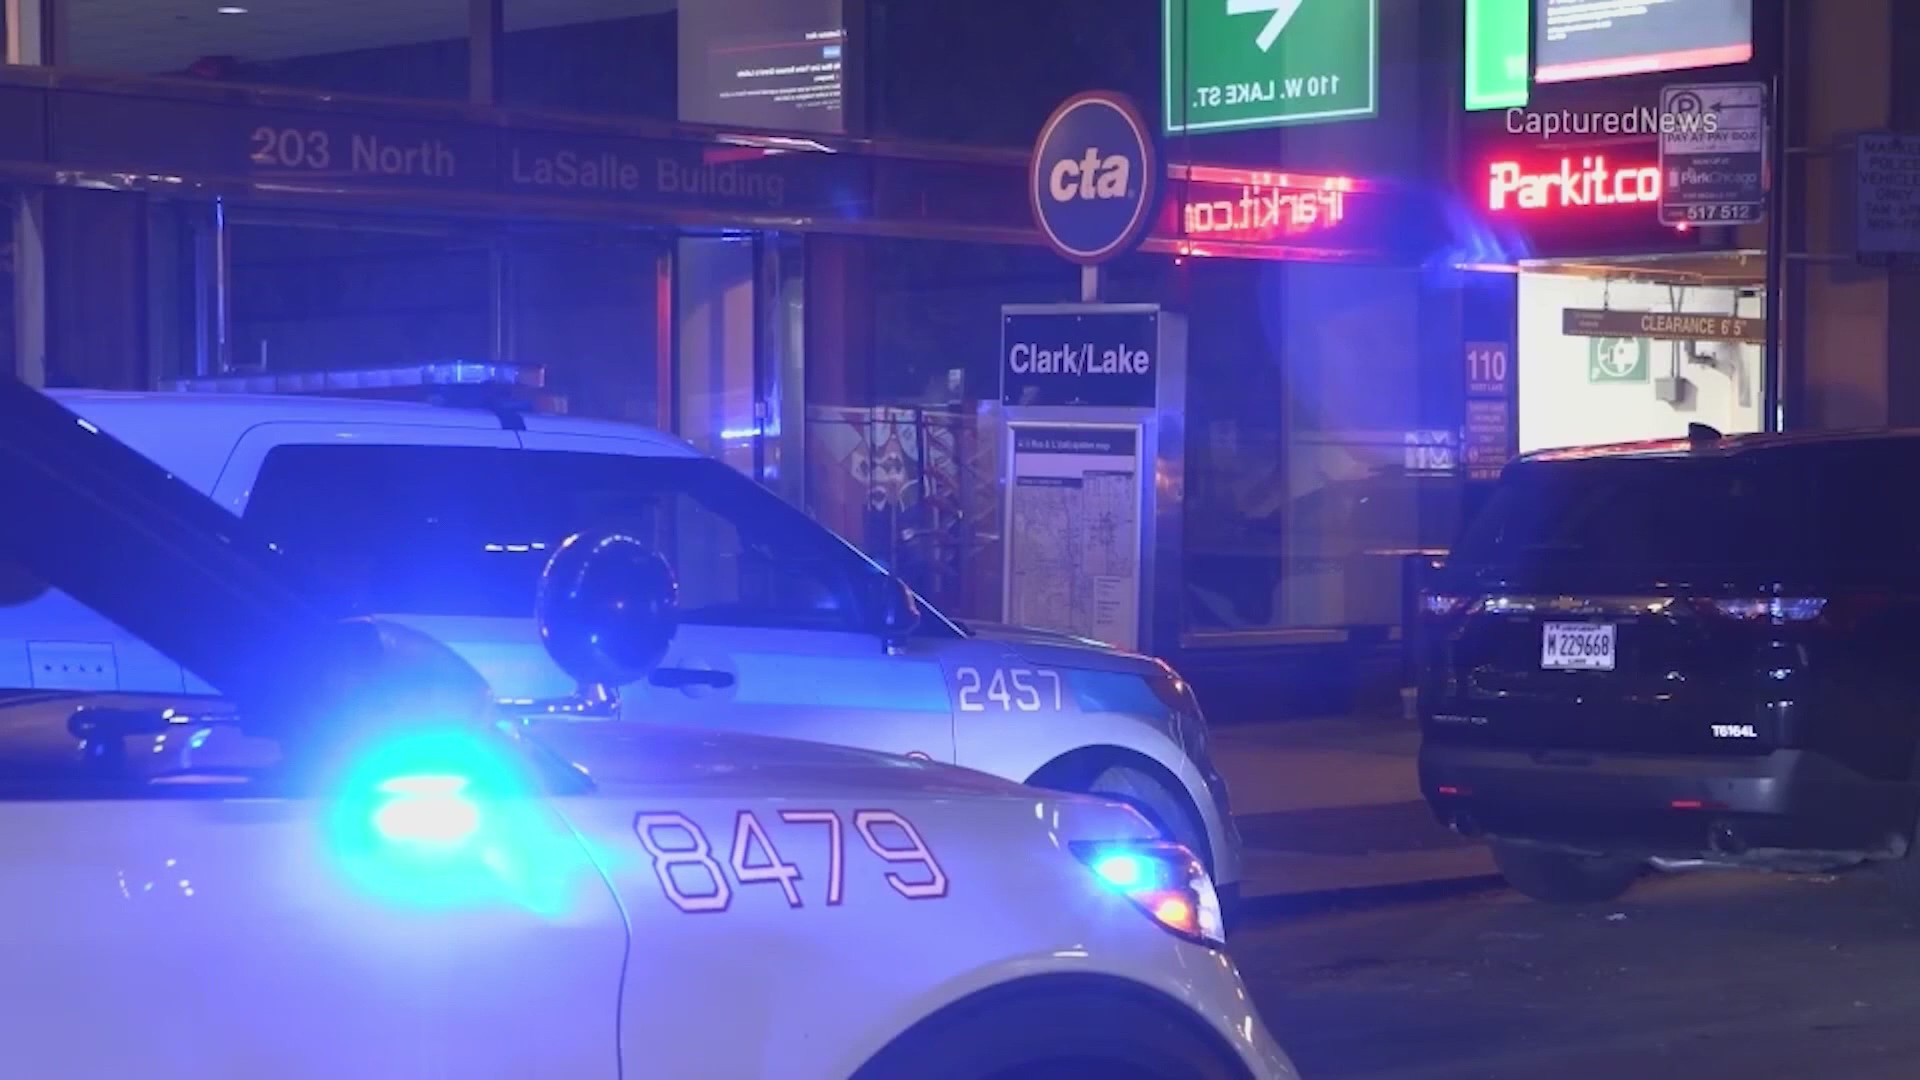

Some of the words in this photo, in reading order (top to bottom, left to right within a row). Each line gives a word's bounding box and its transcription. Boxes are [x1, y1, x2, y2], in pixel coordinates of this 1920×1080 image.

[1708, 131, 1728, 141] PAY
[1732, 131, 1757, 141] BOX
[251, 126, 331, 168] 203
[351, 135, 456, 178] North
[512, 147, 640, 191] LaSalle
[656, 157, 785, 207] Building
[1050, 147, 1129, 201] cta
[1681, 170, 1757, 185] ParkChicago
[1721, 205, 1749, 219] 512
[1641, 315, 1715, 335] CLEARANCE
[1010, 342, 1149, 377] Clark/Lake
[1467, 350, 1507, 381] 110
[1560, 633, 1610, 656] 229668
[957, 667, 1062, 712] 2457
[634, 809, 948, 913] 8479
